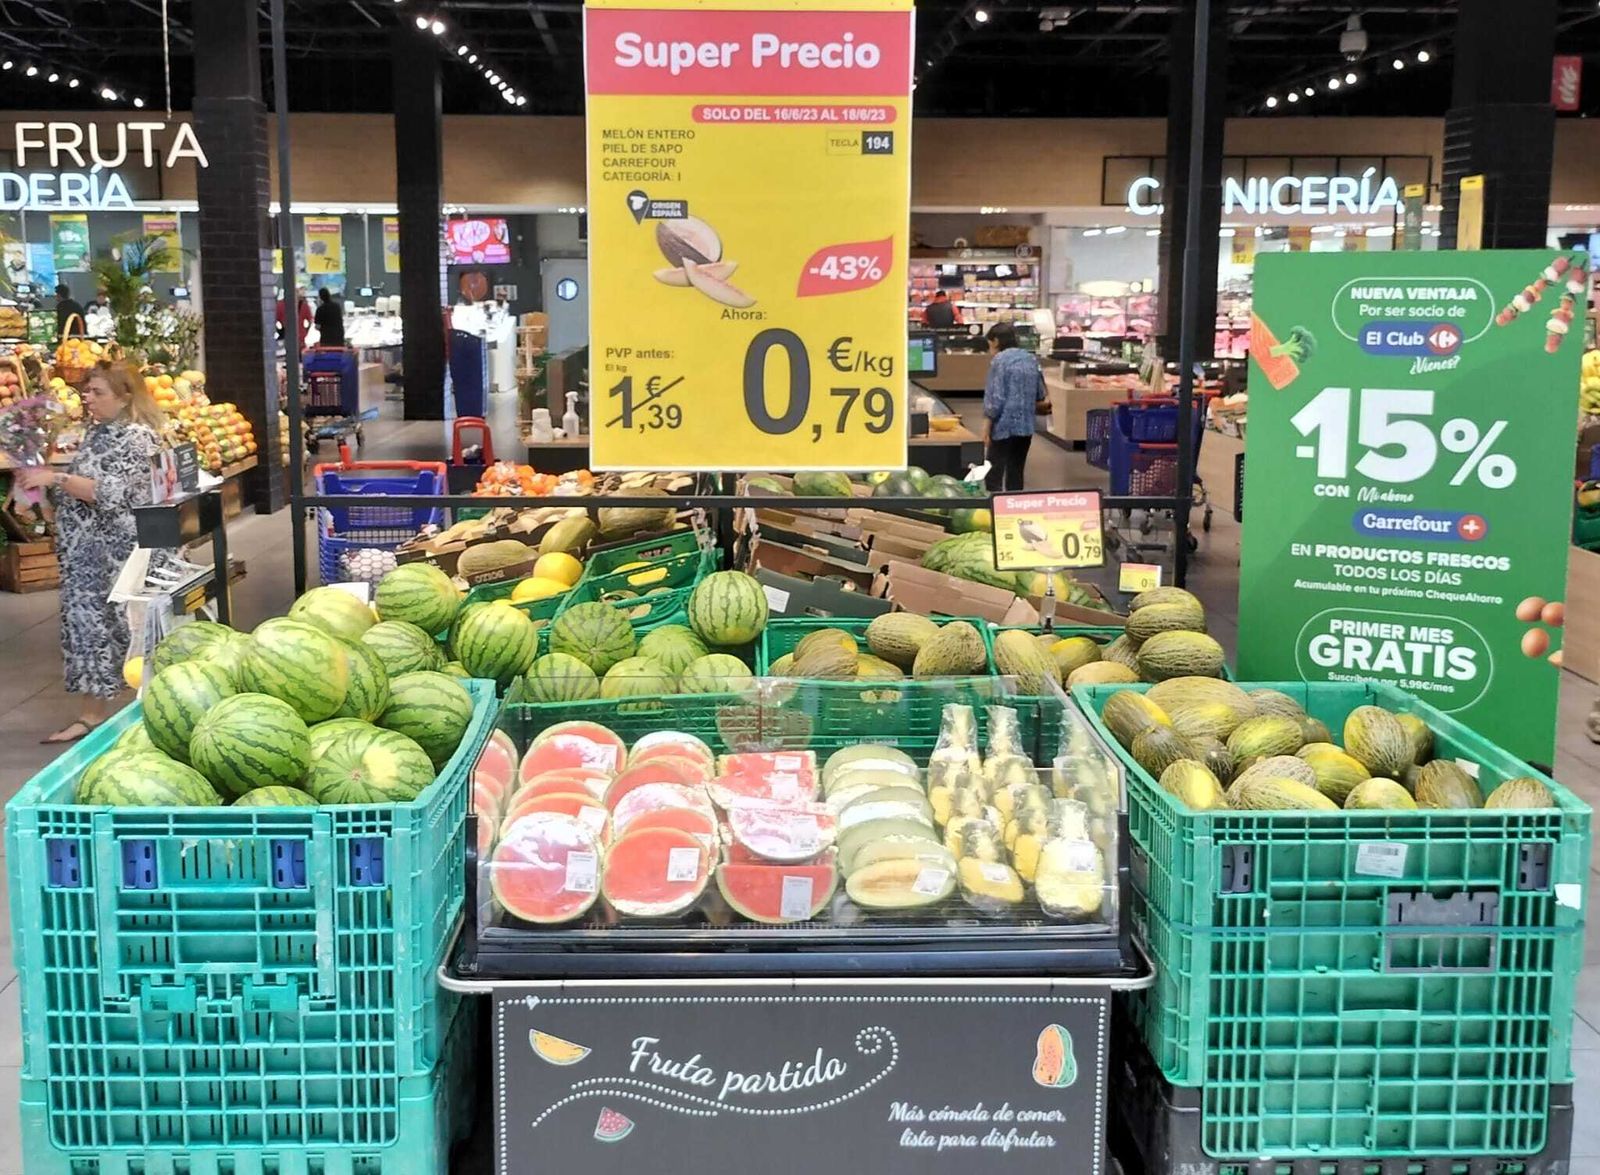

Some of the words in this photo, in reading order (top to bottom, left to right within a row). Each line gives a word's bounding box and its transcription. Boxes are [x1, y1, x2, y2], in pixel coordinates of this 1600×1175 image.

[615, 32, 740, 75] Super
[752, 32, 880, 68] Precio
[703, 108, 741, 120] SOLO
[745, 109, 770, 120] DEL
[820, 109, 838, 120] AL
[603, 128, 643, 139] MELÓN
[648, 130, 695, 139] ENTERO
[830, 139, 858, 147] TECLA
[866, 137, 890, 149] 194
[15, 122, 209, 168] FRUTA
[603, 144, 627, 153] PIEL
[632, 144, 646, 153] DE
[651, 144, 682, 153] SAPO
[603, 158, 676, 168] CARREFOUR
[1128, 167, 1405, 215] CNICERÍA
[809, 255, 882, 281] -43%
[1351, 287, 1402, 301] NUEVA
[1407, 287, 1477, 301] VENTAJA
[721, 308, 767, 321] Ahora:
[1359, 303, 1383, 316] Por
[1384, 305, 1406, 316] ser
[1408, 303, 1444, 317] socio
[1448, 304, 1466, 317] de
[1366, 331, 1382, 345] El
[1387, 331, 1424, 346] Club
[606, 348, 632, 358] PVP
[636, 349, 674, 359] antes:
[828, 337, 893, 378] €/kg
[1410, 356, 1461, 375] ¿Vienes?
[1290, 387, 1517, 489] -15%
[1314, 485, 1349, 497] CON
[1006, 498, 1043, 510] Super
[1047, 496, 1087, 507] Precio
[1363, 513, 1452, 533] Carrefour
[1291, 544, 1311, 557] EN
[1315, 544, 1423, 565] PRODUCTOS
[1427, 552, 1510, 571] FRESCOS
[1334, 564, 1387, 579] TODOS
[1391, 569, 1421, 583] LOS
[1425, 569, 1462, 586] DÍAS
[1294, 579, 1351, 592] Acumulable
[1354, 586, 1367, 594] en
[1369, 585, 1380, 595] tu
[1382, 586, 1423, 598] próximo
[1426, 589, 1503, 605] ChequeAhorro
[1330, 618, 1405, 641] PRIMER
[1410, 628, 1454, 644] MES
[1309, 635, 1477, 681] GRATIS
[629, 1036, 716, 1087] Fruta
[717, 1047, 847, 1101] partida
[888, 1101, 926, 1122] Más
[928, 1102, 990, 1122] cómoda
[992, 1102, 1014, 1121] de
[900, 1127, 938, 1147] lista
[937, 1133, 980, 1152] para
[980, 1127, 1057, 1153] disfrutar
